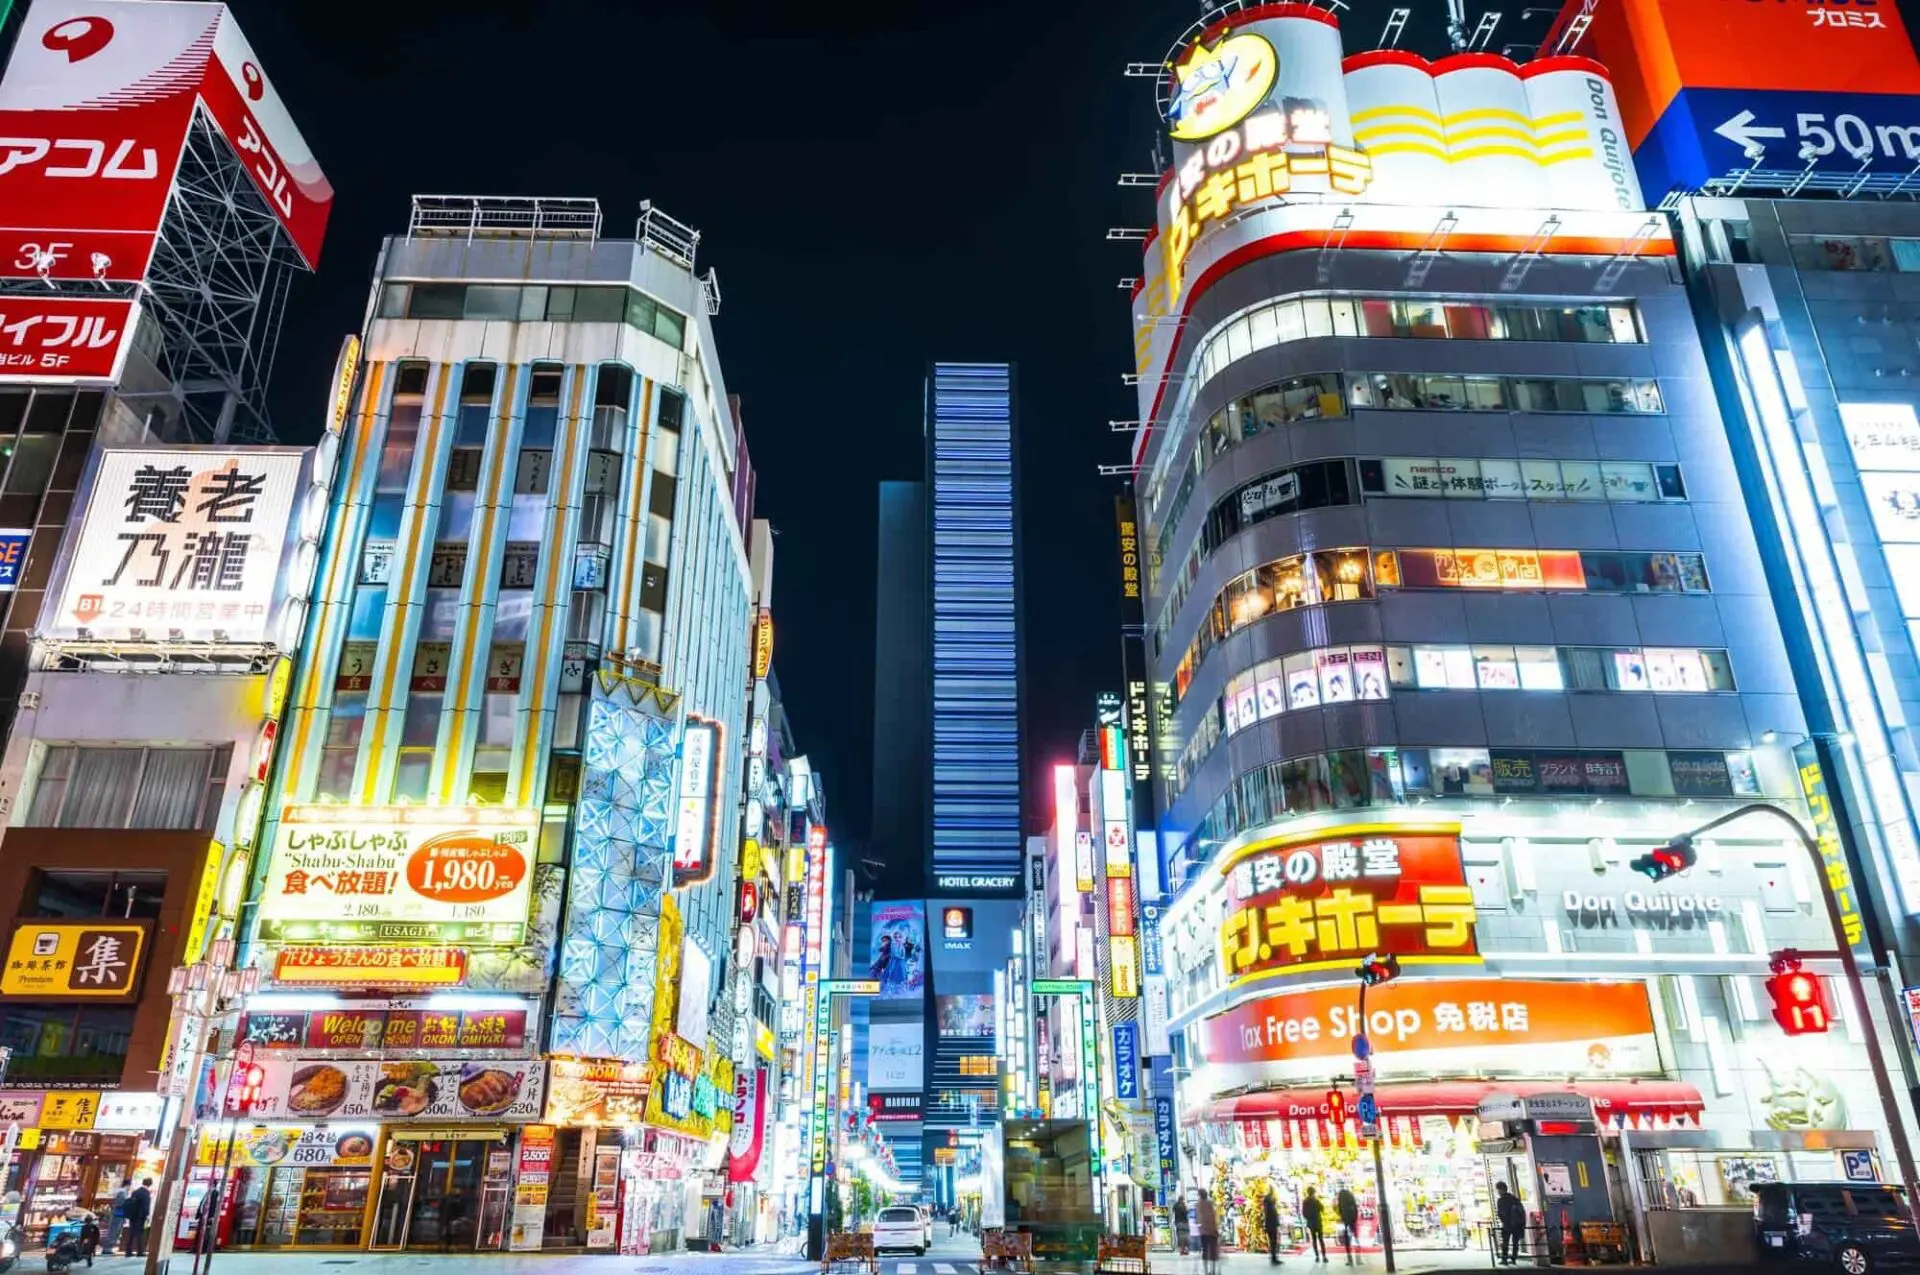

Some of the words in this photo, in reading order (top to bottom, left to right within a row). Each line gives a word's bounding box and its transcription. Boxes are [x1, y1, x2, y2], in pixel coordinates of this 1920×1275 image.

[1806, 8, 1888, 29] プロミス
[1586, 78, 1604, 120] Don
[1601, 127, 1632, 210] Quijote
[0, 137, 158, 180] アコム
[238, 115, 293, 219] アコム
[14, 242, 74, 271] 3F
[40, 353, 70, 367] 5F
[1410, 465, 1457, 474] namco
[124, 464, 267, 523] 養老
[102, 531, 252, 591] 乃瀧
[109, 600, 265, 622] 24時間営業中
[1493, 758, 1533, 779] 販売
[1540, 762, 1579, 776] ブランド
[1585, 761, 1624, 777] 時計
[288, 829, 409, 851] しゃぶしゃぶ
[419, 859, 496, 895] 1,980
[939, 876, 970, 888] HOTEL
[971, 876, 1015, 888] GRACERY
[1563, 890, 1617, 912] Don
[1624, 889, 1723, 917] Quijote
[945, 942, 972, 950] IMAX
[76, 935, 127, 984] 集
[322, 1014, 418, 1035] Welcome
[1240, 1023, 1263, 1051] Tax
[1266, 1013, 1320, 1047] Free
[1329, 1005, 1422, 1047] Shop
[1432, 1001, 1530, 1034] 免税店
[331, 1034, 361, 1045] OPEN
[1117, 1028, 1136, 1097] カラオケ
[526, 1063, 542, 1101] かつ丼
[1289, 1103, 1316, 1115] Don
[1157, 1099, 1173, 1157] カラオケ
[1159, 1158, 1173, 1170] B1
[1846, 1155, 1859, 1177] P
